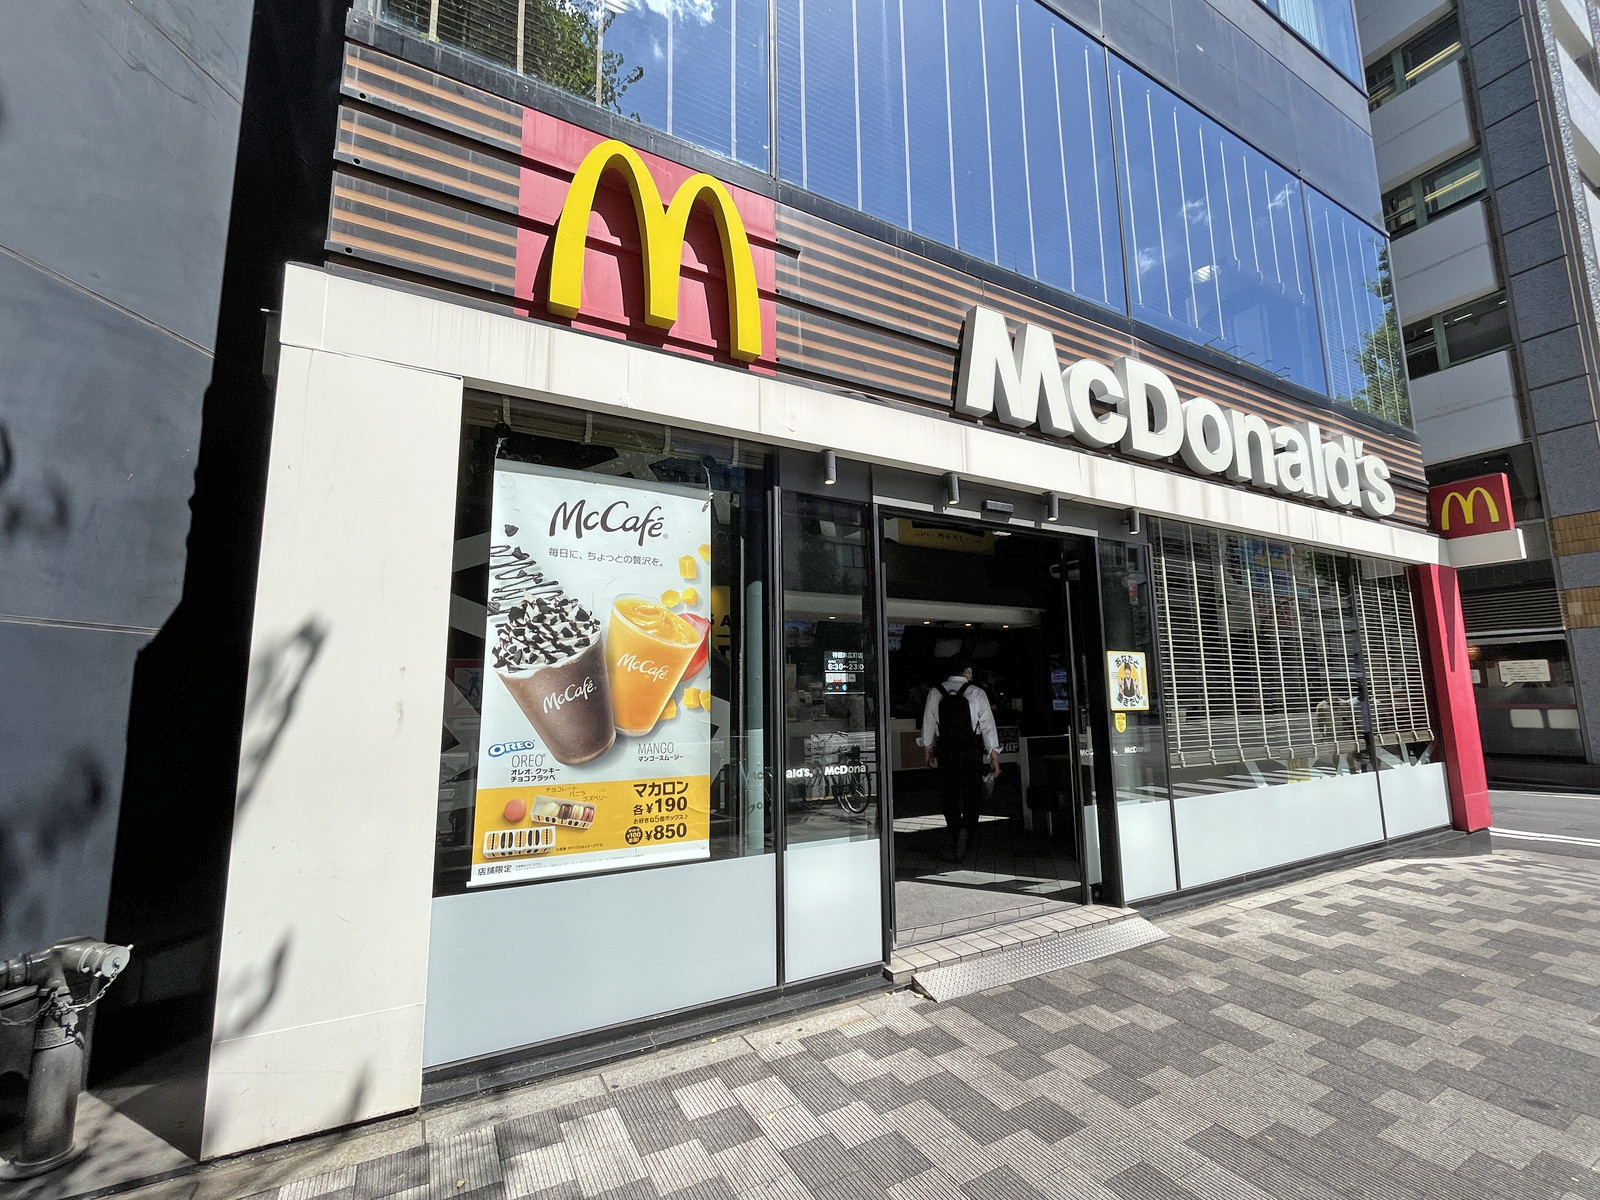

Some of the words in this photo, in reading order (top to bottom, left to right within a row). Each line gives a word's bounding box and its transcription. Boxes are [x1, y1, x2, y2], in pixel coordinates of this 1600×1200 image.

[955, 305, 1397, 518] McDonald's
[548, 547, 664, 568] 毎日に、ちょっとの贅沢を。
[488, 741, 534, 756] OREO
[638, 742, 674, 754] MANGO
[638, 754, 684, 762] マンゴースムージー
[633, 781, 689, 798] マカロン
[645, 823, 688, 841] ¥850
[477, 865, 512, 876] 店舗限定
